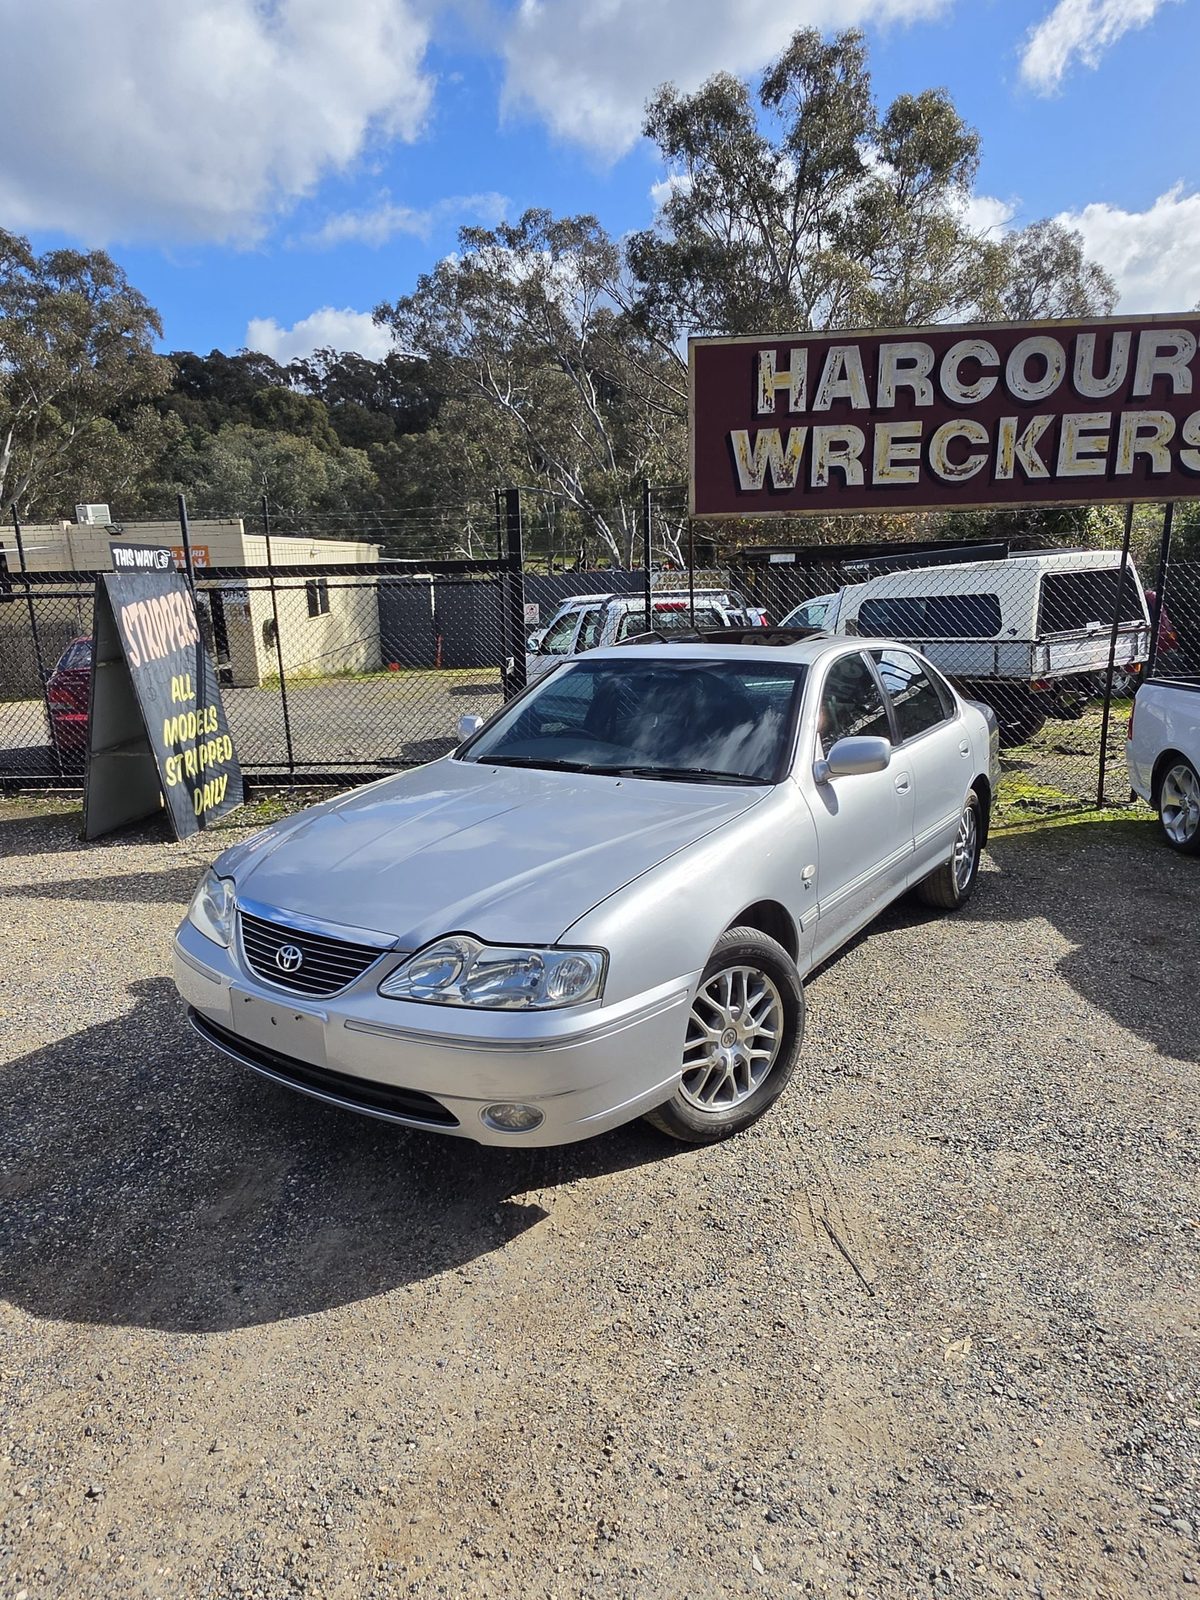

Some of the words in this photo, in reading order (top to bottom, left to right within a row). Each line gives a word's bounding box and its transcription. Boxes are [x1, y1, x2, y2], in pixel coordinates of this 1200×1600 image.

[757, 329, 1200, 414] HARCOUR
[113, 548, 134, 566] THIS
[134, 550, 154, 567] WAY
[121, 590, 200, 667] STRIPPERS
[171, 673, 195, 704] ALL
[163, 705, 218, 747] MODELS
[165, 734, 233, 786] STRIPPED
[193, 773, 228, 815] DAILY
